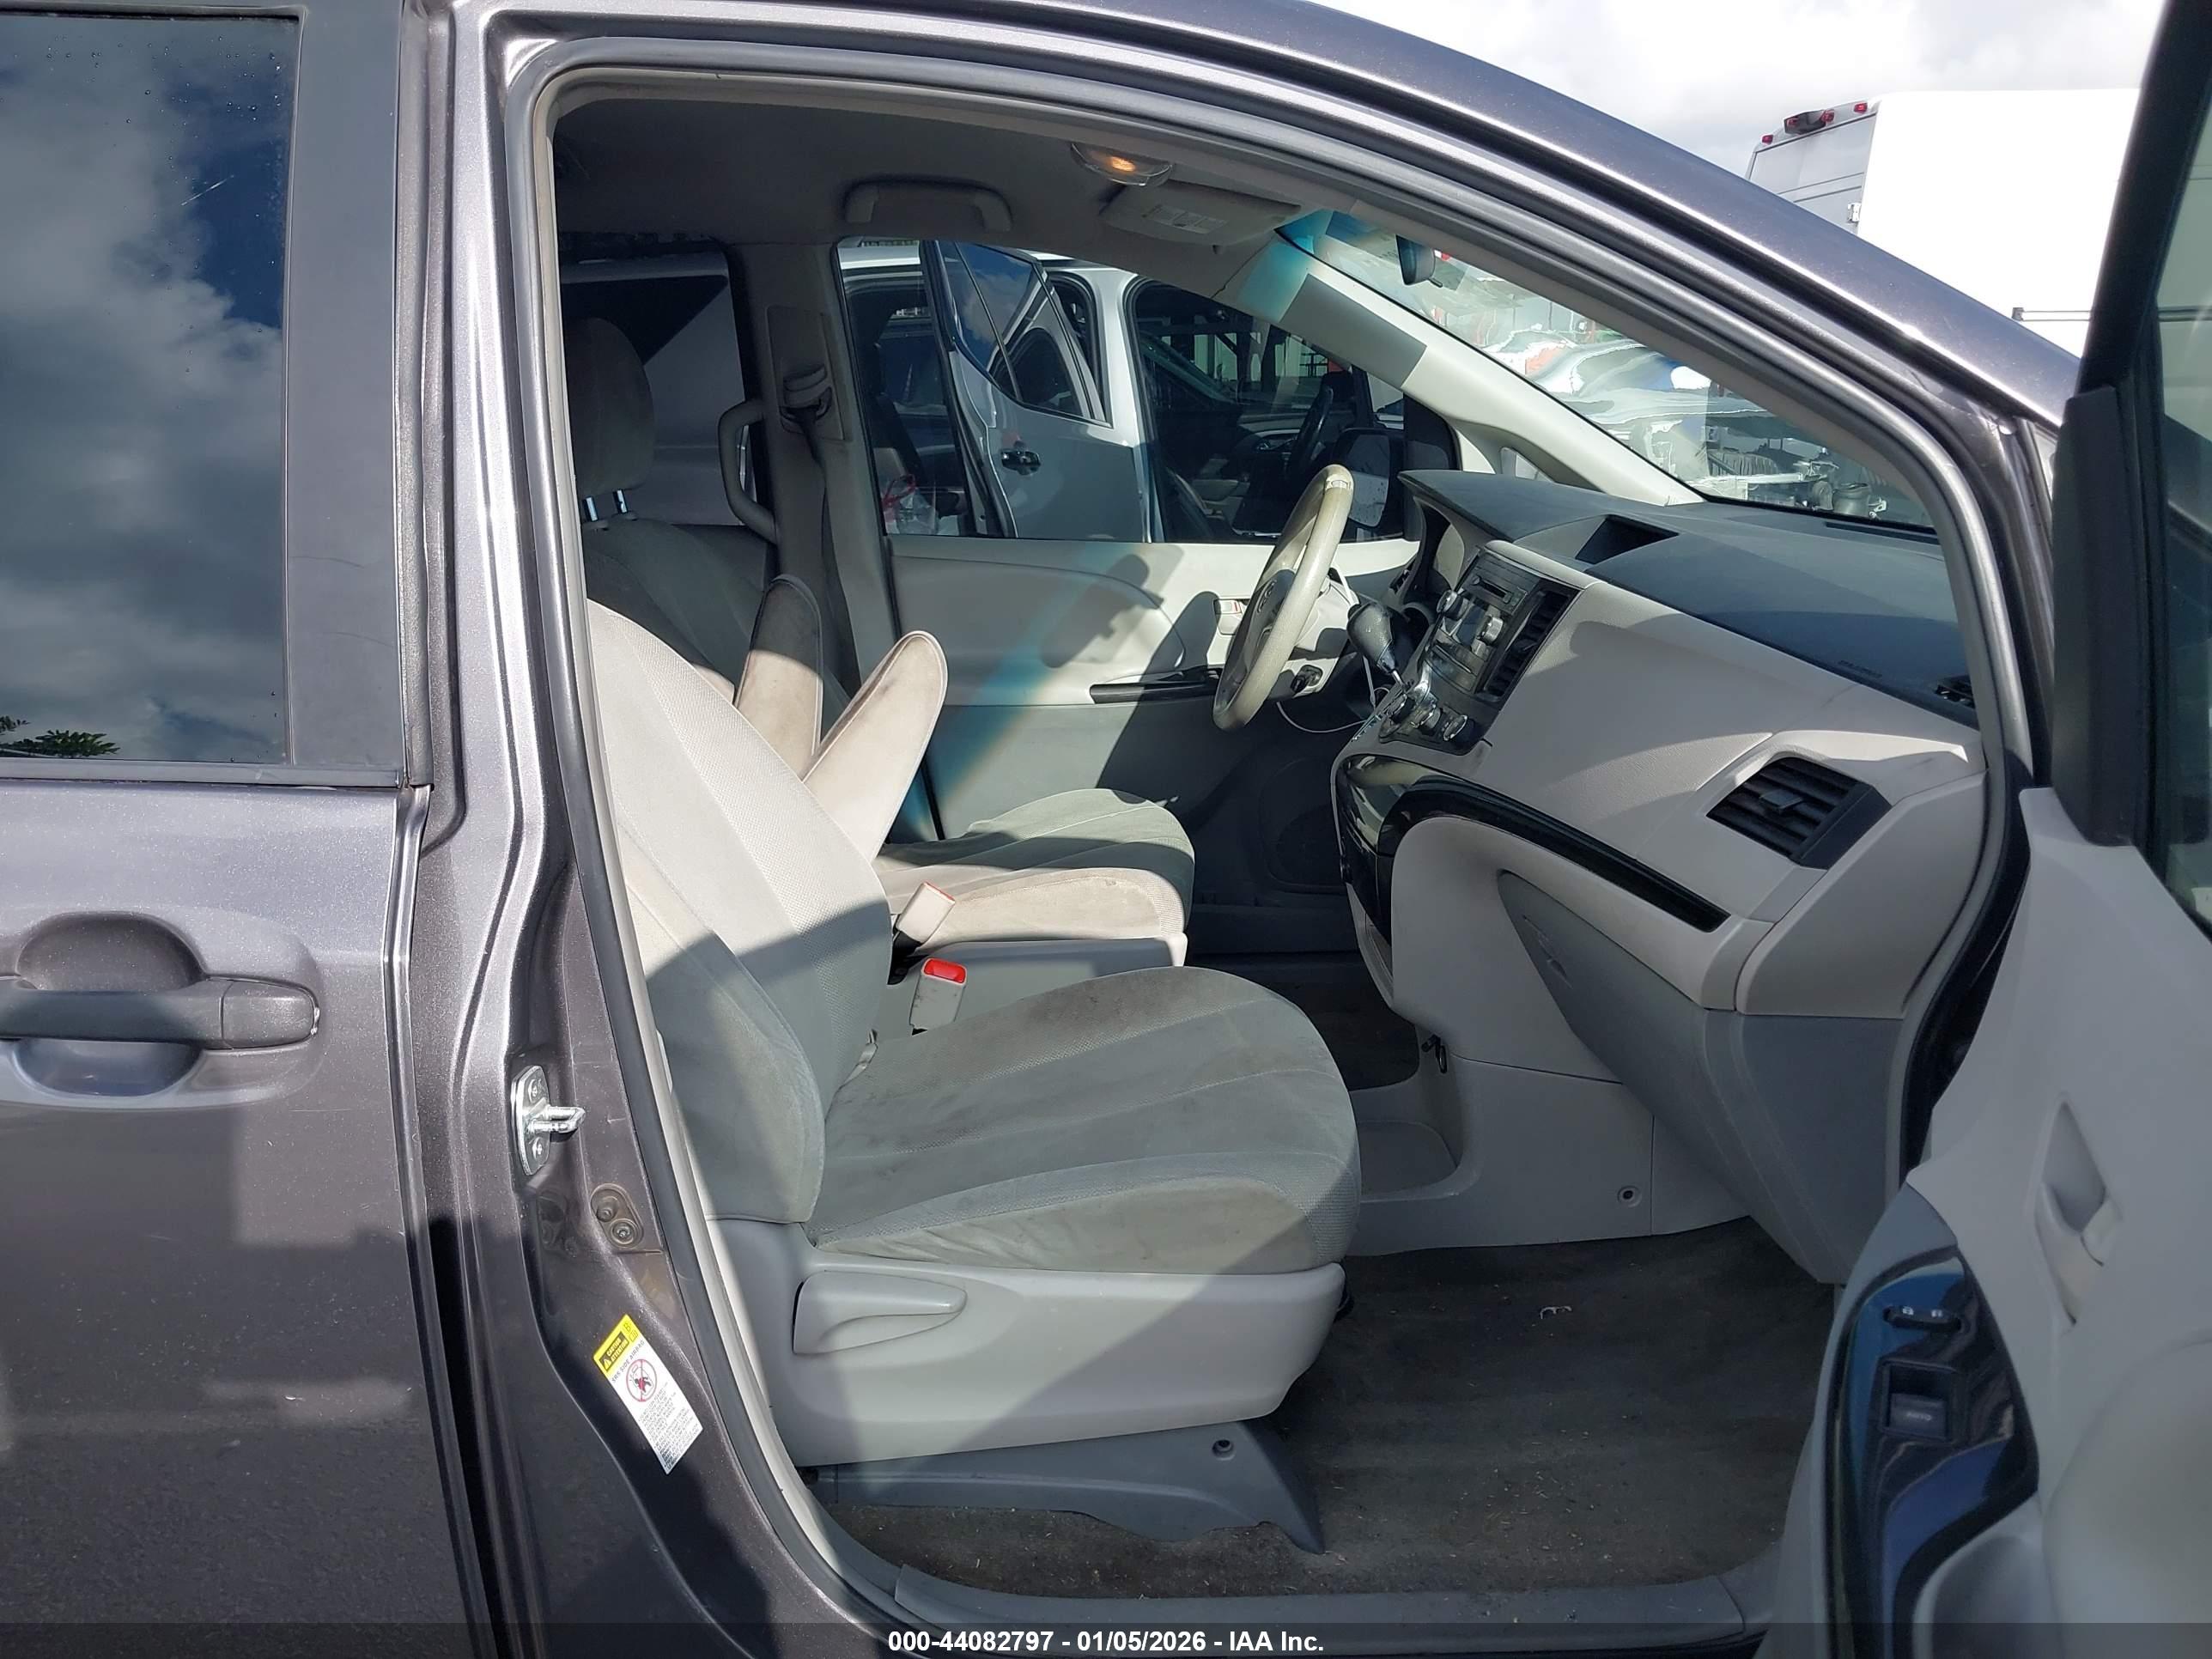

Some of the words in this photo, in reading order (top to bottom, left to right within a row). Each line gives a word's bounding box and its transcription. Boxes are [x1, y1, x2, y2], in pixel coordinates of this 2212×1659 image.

[606, 1338, 622, 1357] CAUTION
[610, 1339, 629, 1362] ATTENTION
[619, 1357, 630, 1372] SIDE
[629, 1340, 645, 1359] AIRBAG
